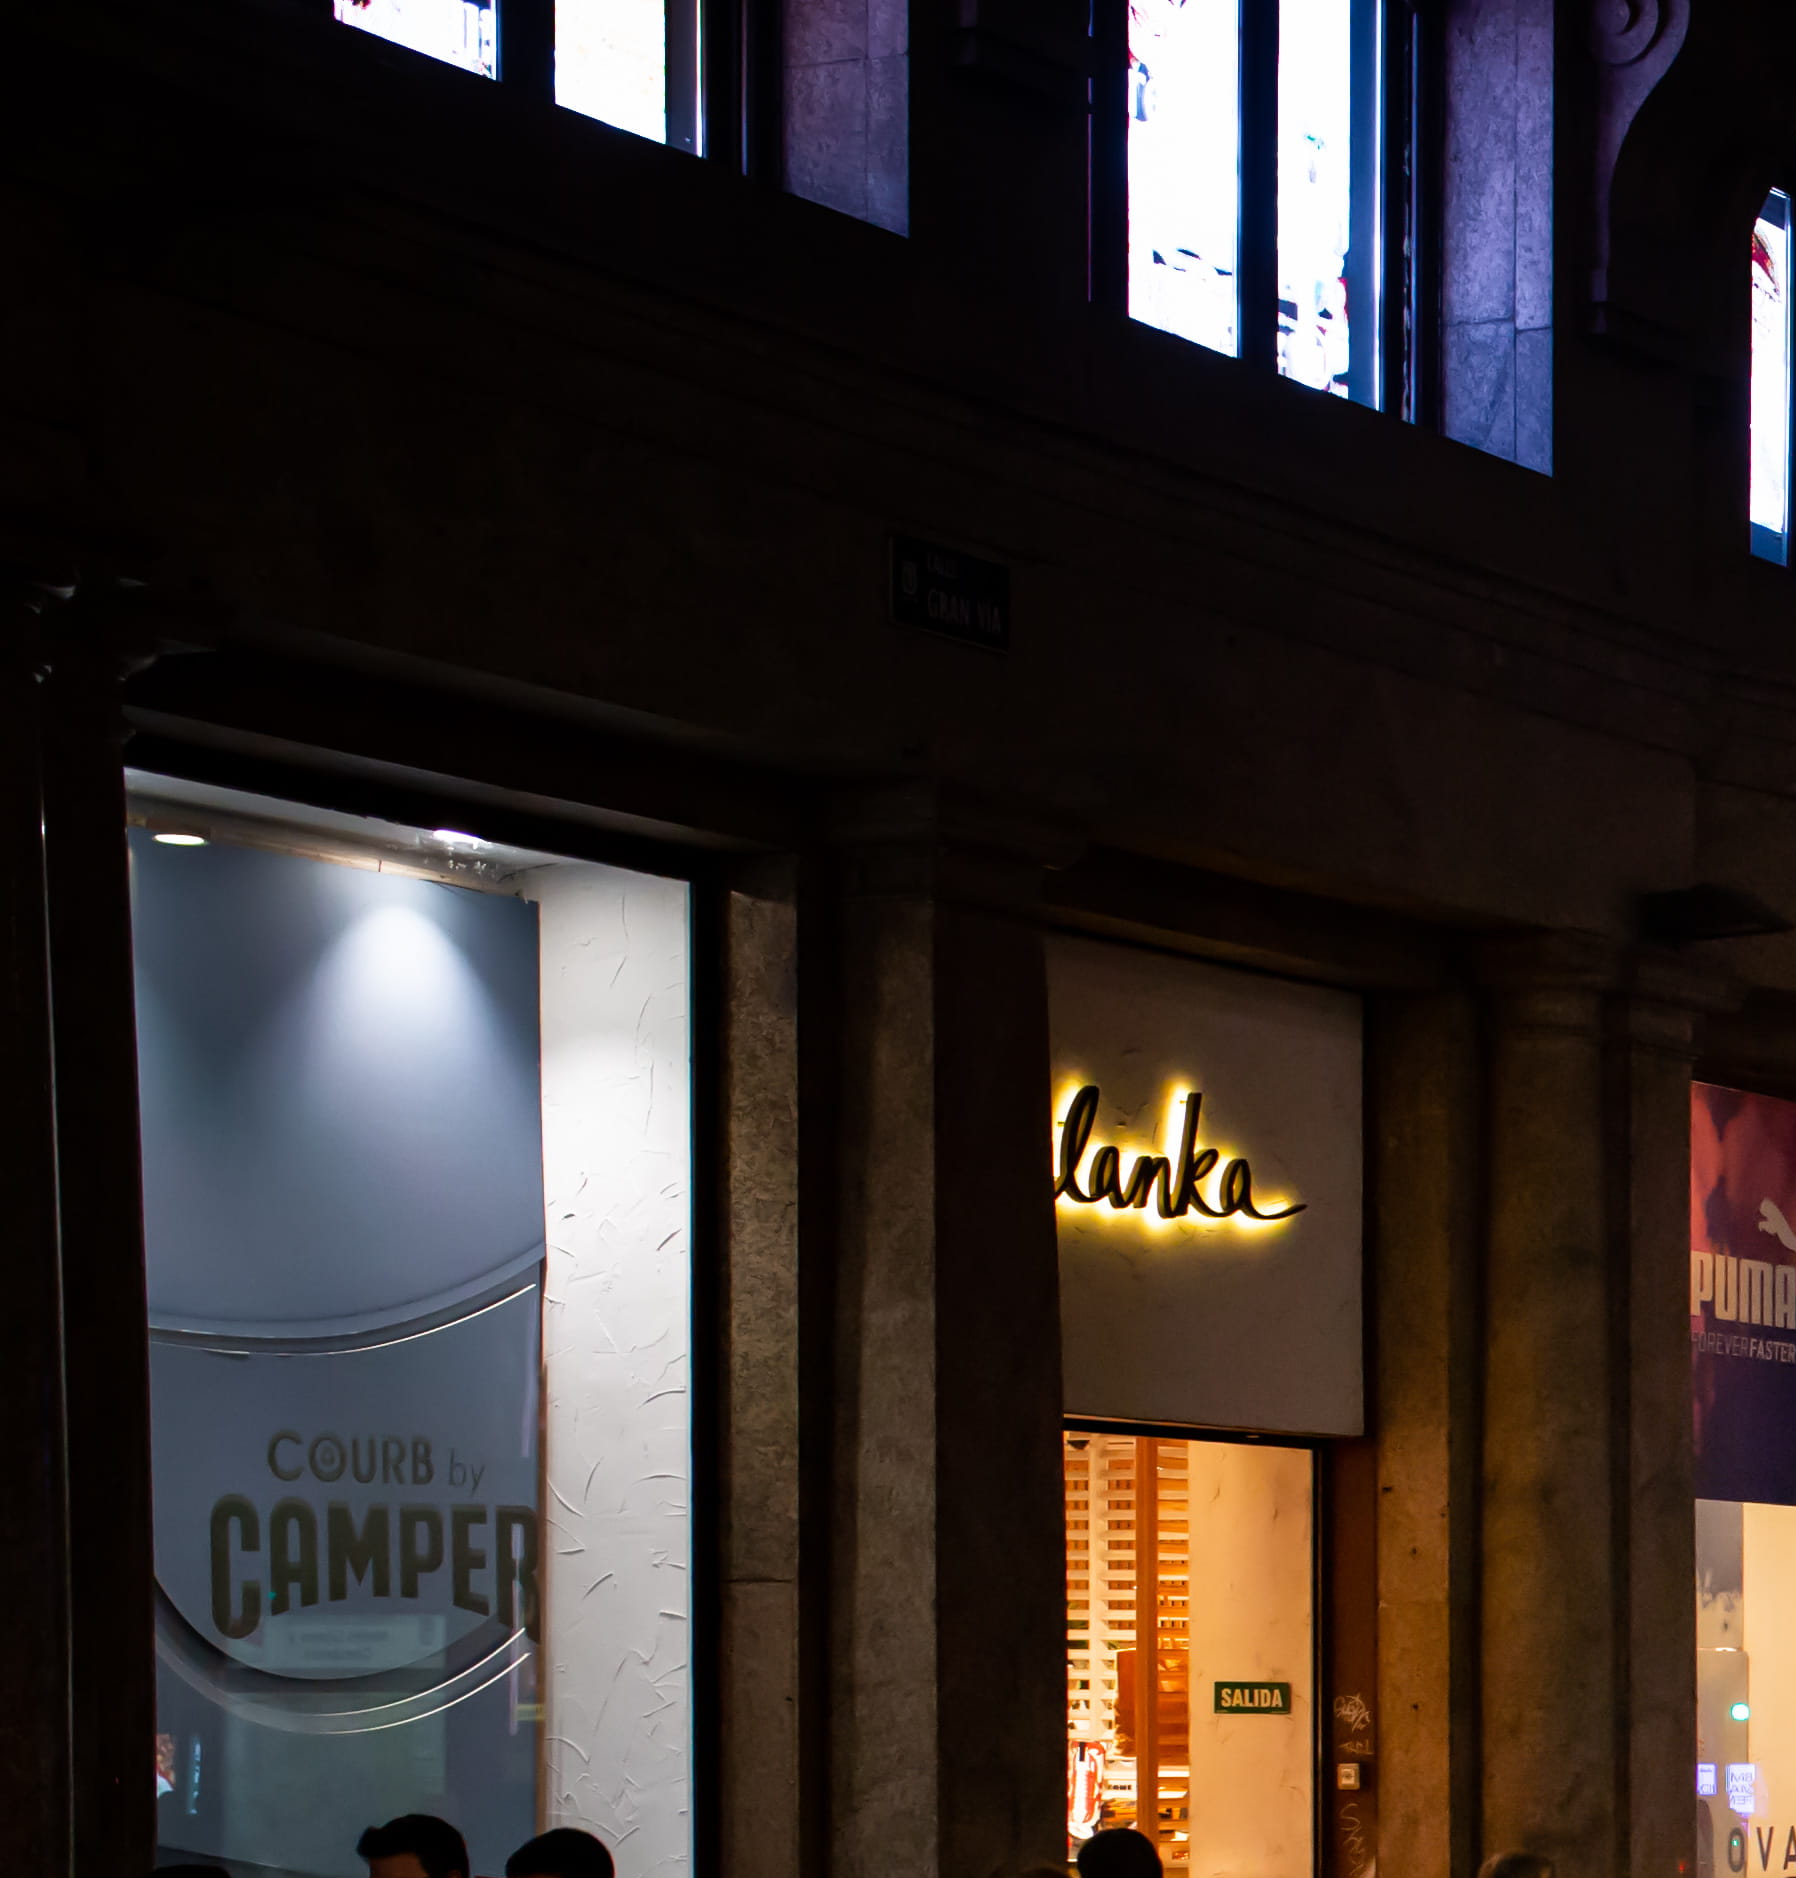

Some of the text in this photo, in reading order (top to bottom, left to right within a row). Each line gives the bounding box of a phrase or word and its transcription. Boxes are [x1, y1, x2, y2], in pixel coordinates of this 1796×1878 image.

[1053, 1085, 1308, 1220] lanka
[267, 1429, 486, 1493] COURB by
[210, 1492, 540, 1646] CAMPER
[1220, 1688, 1283, 1708] SALIDA
